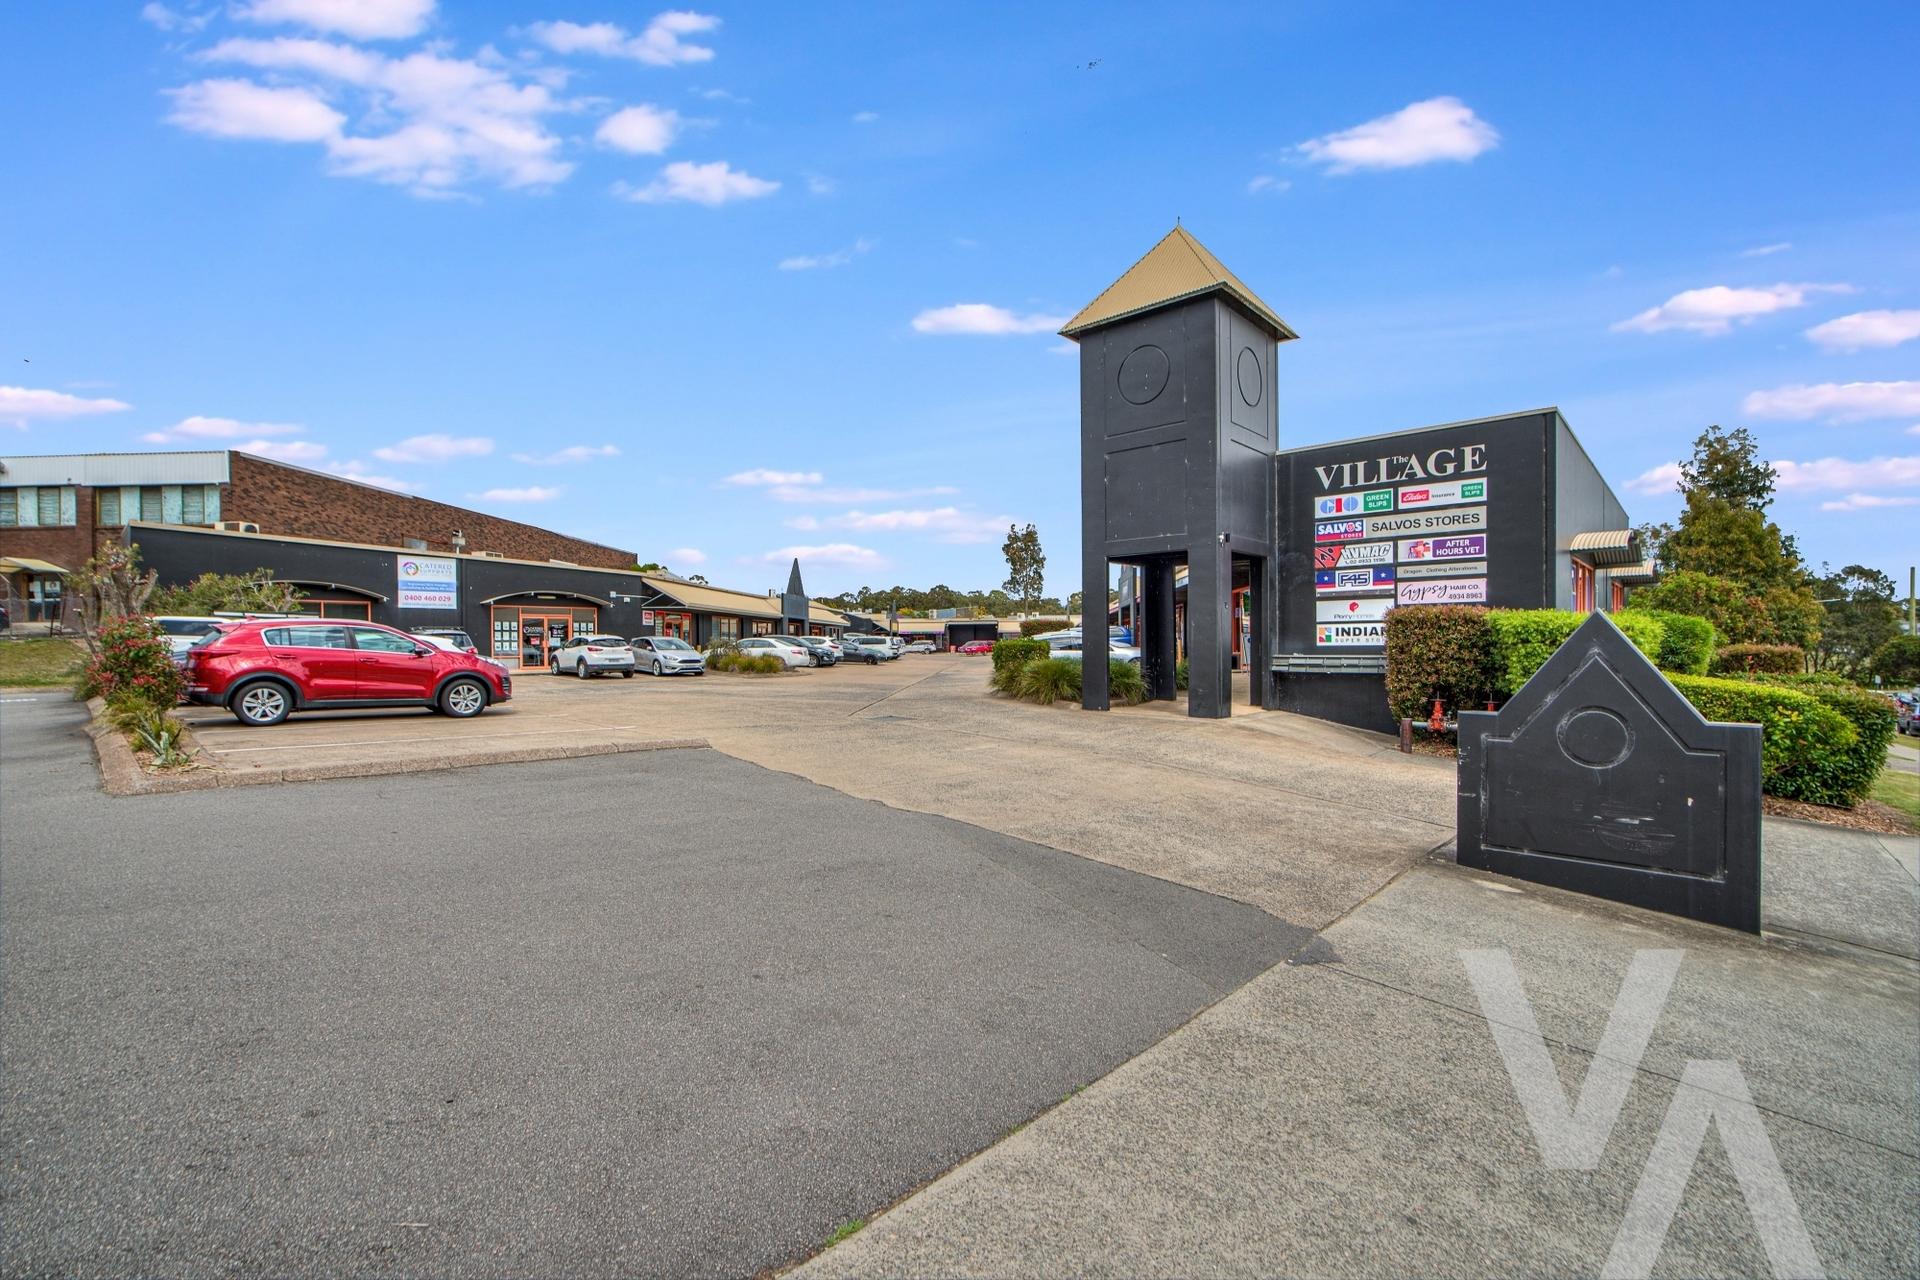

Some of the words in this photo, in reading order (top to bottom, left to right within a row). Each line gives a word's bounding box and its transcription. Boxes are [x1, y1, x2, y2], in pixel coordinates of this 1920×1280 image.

[1392, 455, 1409, 464] The
[1315, 444, 1487, 490] VILLAGE
[1368, 500, 1387, 508] SLIPS
[1318, 521, 1362, 535] SALVOS
[1372, 518, 1421, 532] SALVOS
[1425, 513, 1480, 527] STORES
[1446, 539, 1469, 548] AFTER
[1436, 547, 1463, 555] HOURS
[1465, 546, 1480, 554] VET
[1340, 573, 1368, 586] F45
[1401, 584, 1447, 601] Gypsy
